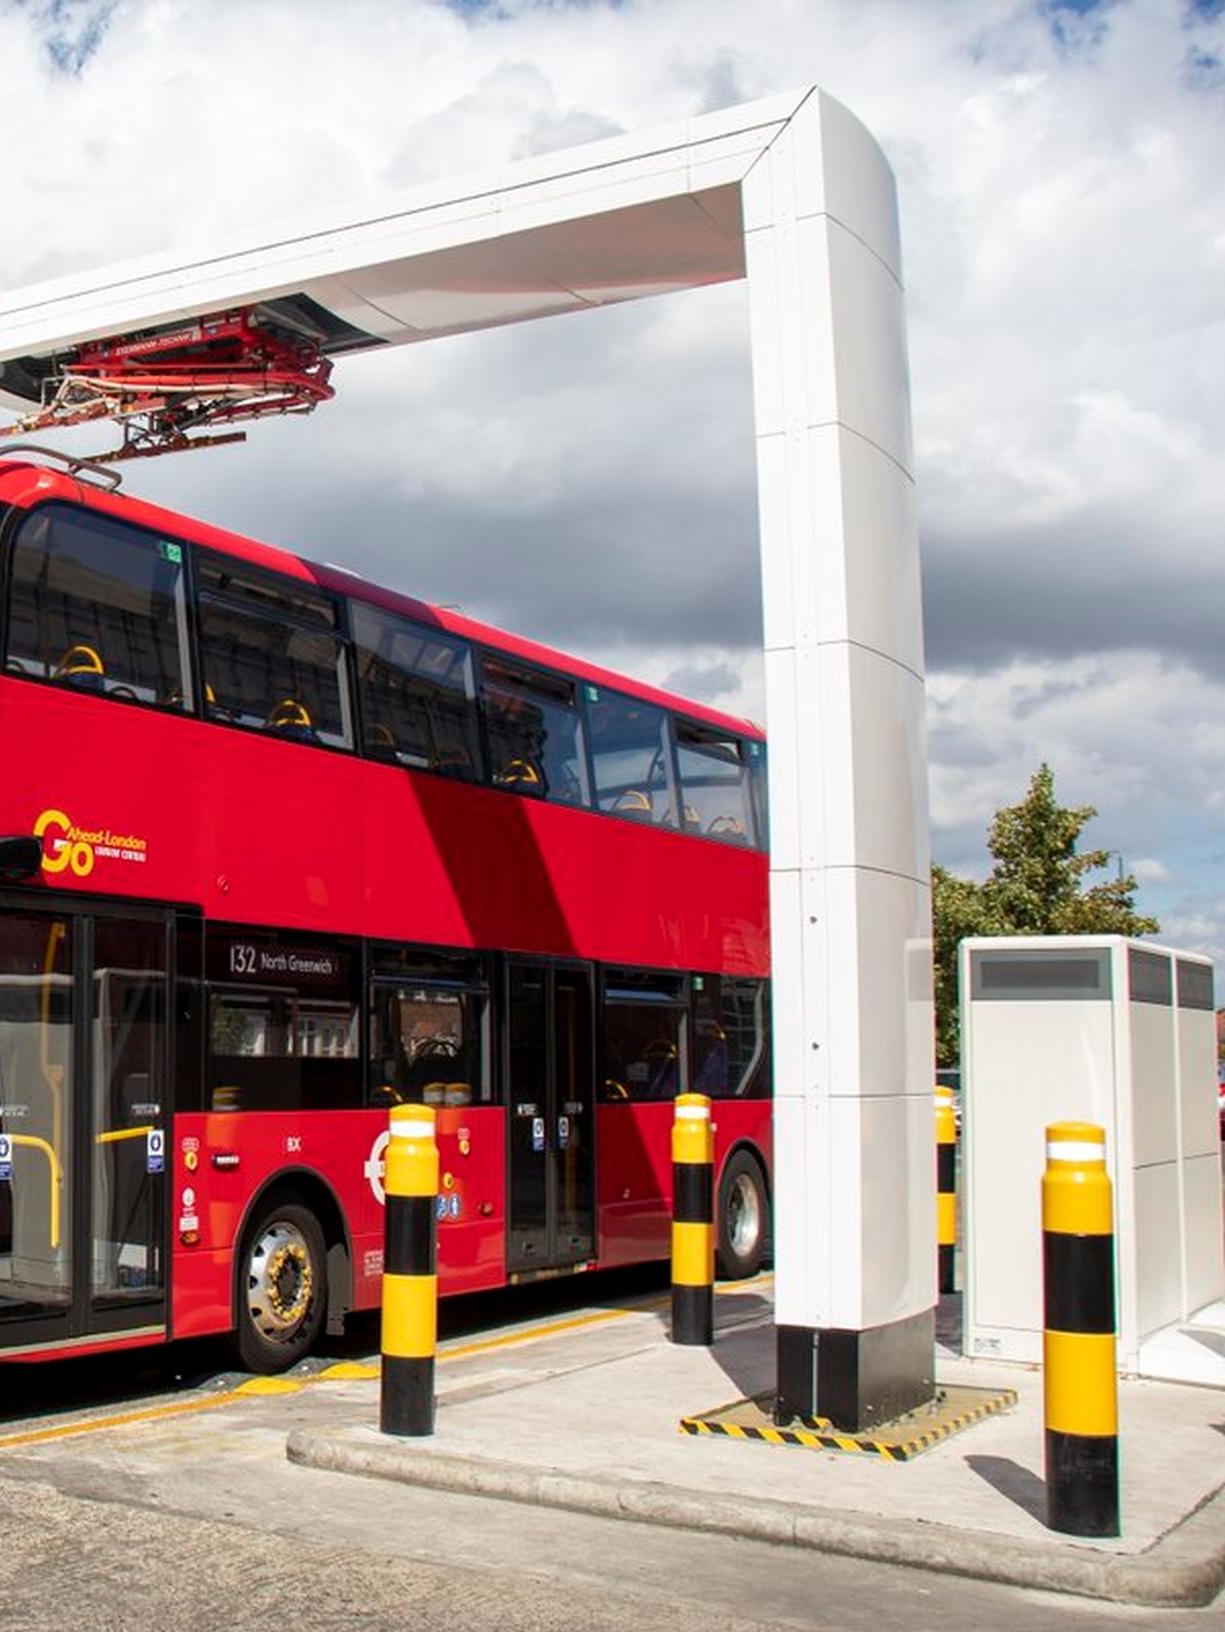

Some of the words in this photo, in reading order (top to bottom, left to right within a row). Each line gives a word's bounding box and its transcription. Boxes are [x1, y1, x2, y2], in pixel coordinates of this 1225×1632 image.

[66, 827, 146, 851] Ahead-London
[230, 944, 257, 973] 132
[261, 952, 287, 971] North
[288, 955, 332, 974] Greenwich
